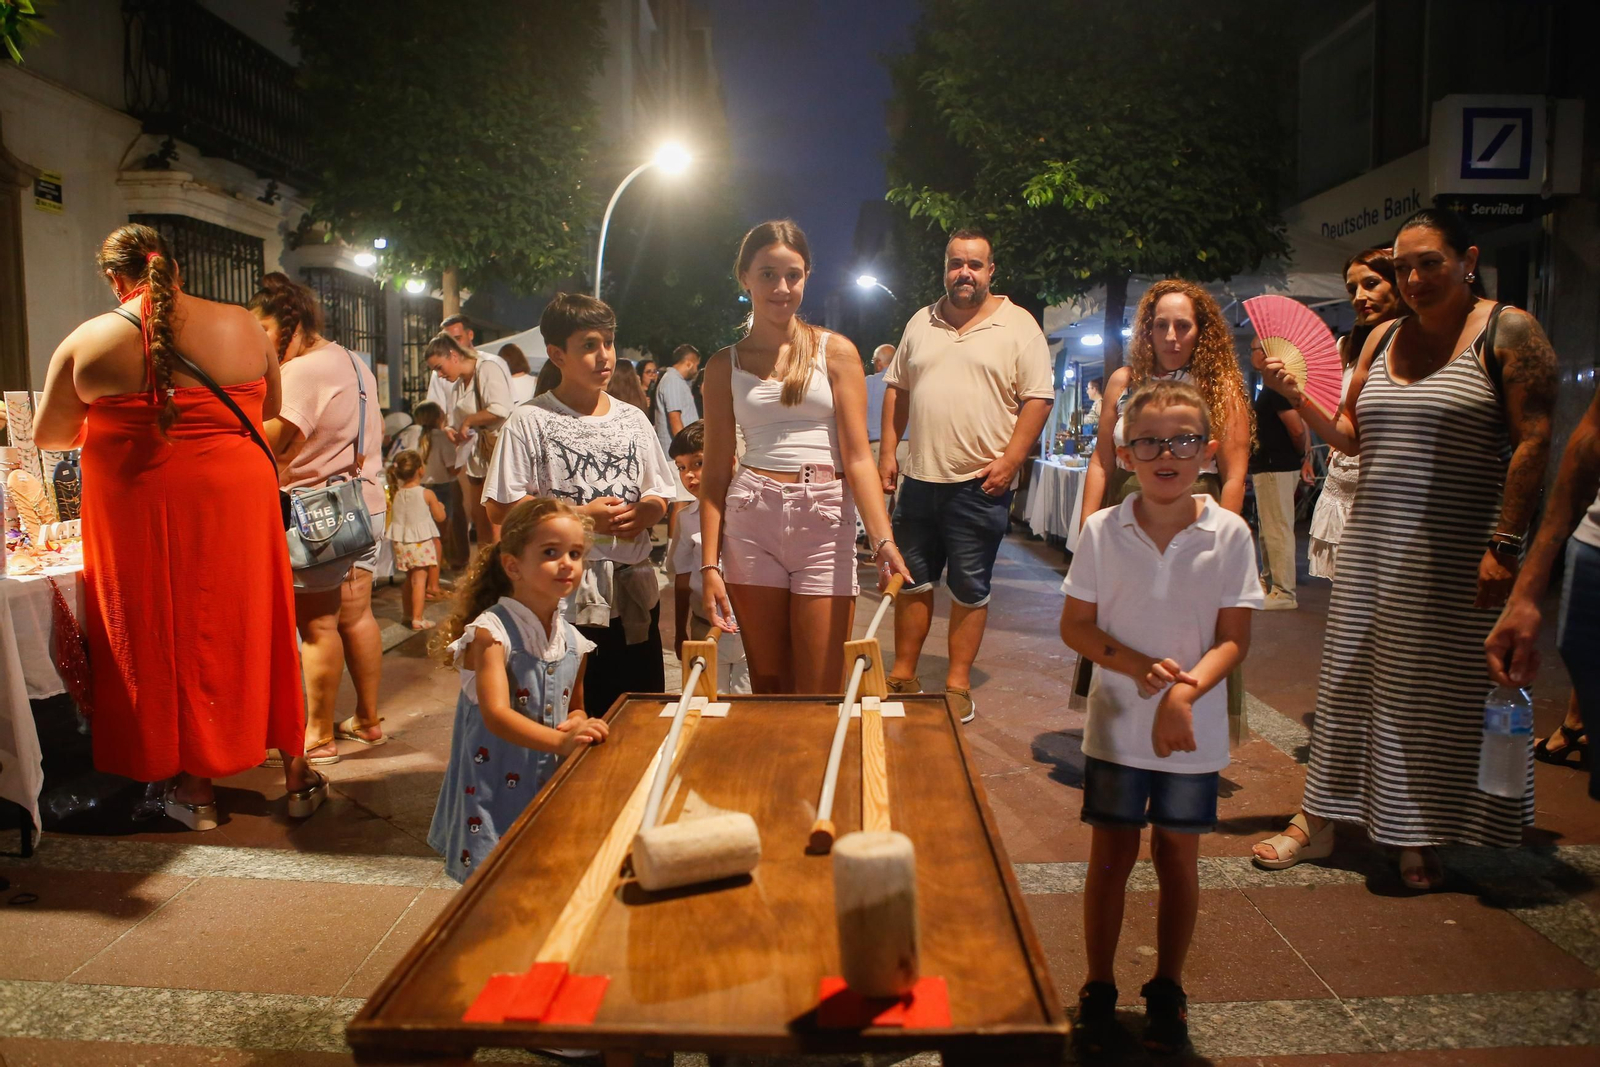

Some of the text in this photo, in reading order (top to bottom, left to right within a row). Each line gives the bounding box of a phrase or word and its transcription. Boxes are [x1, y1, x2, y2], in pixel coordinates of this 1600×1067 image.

[1321, 188, 1421, 239] Deutsche Bank
[1471, 203, 1524, 215] ServiRed
[304, 506, 333, 521] THE
[286, 520, 325, 538] TTE
